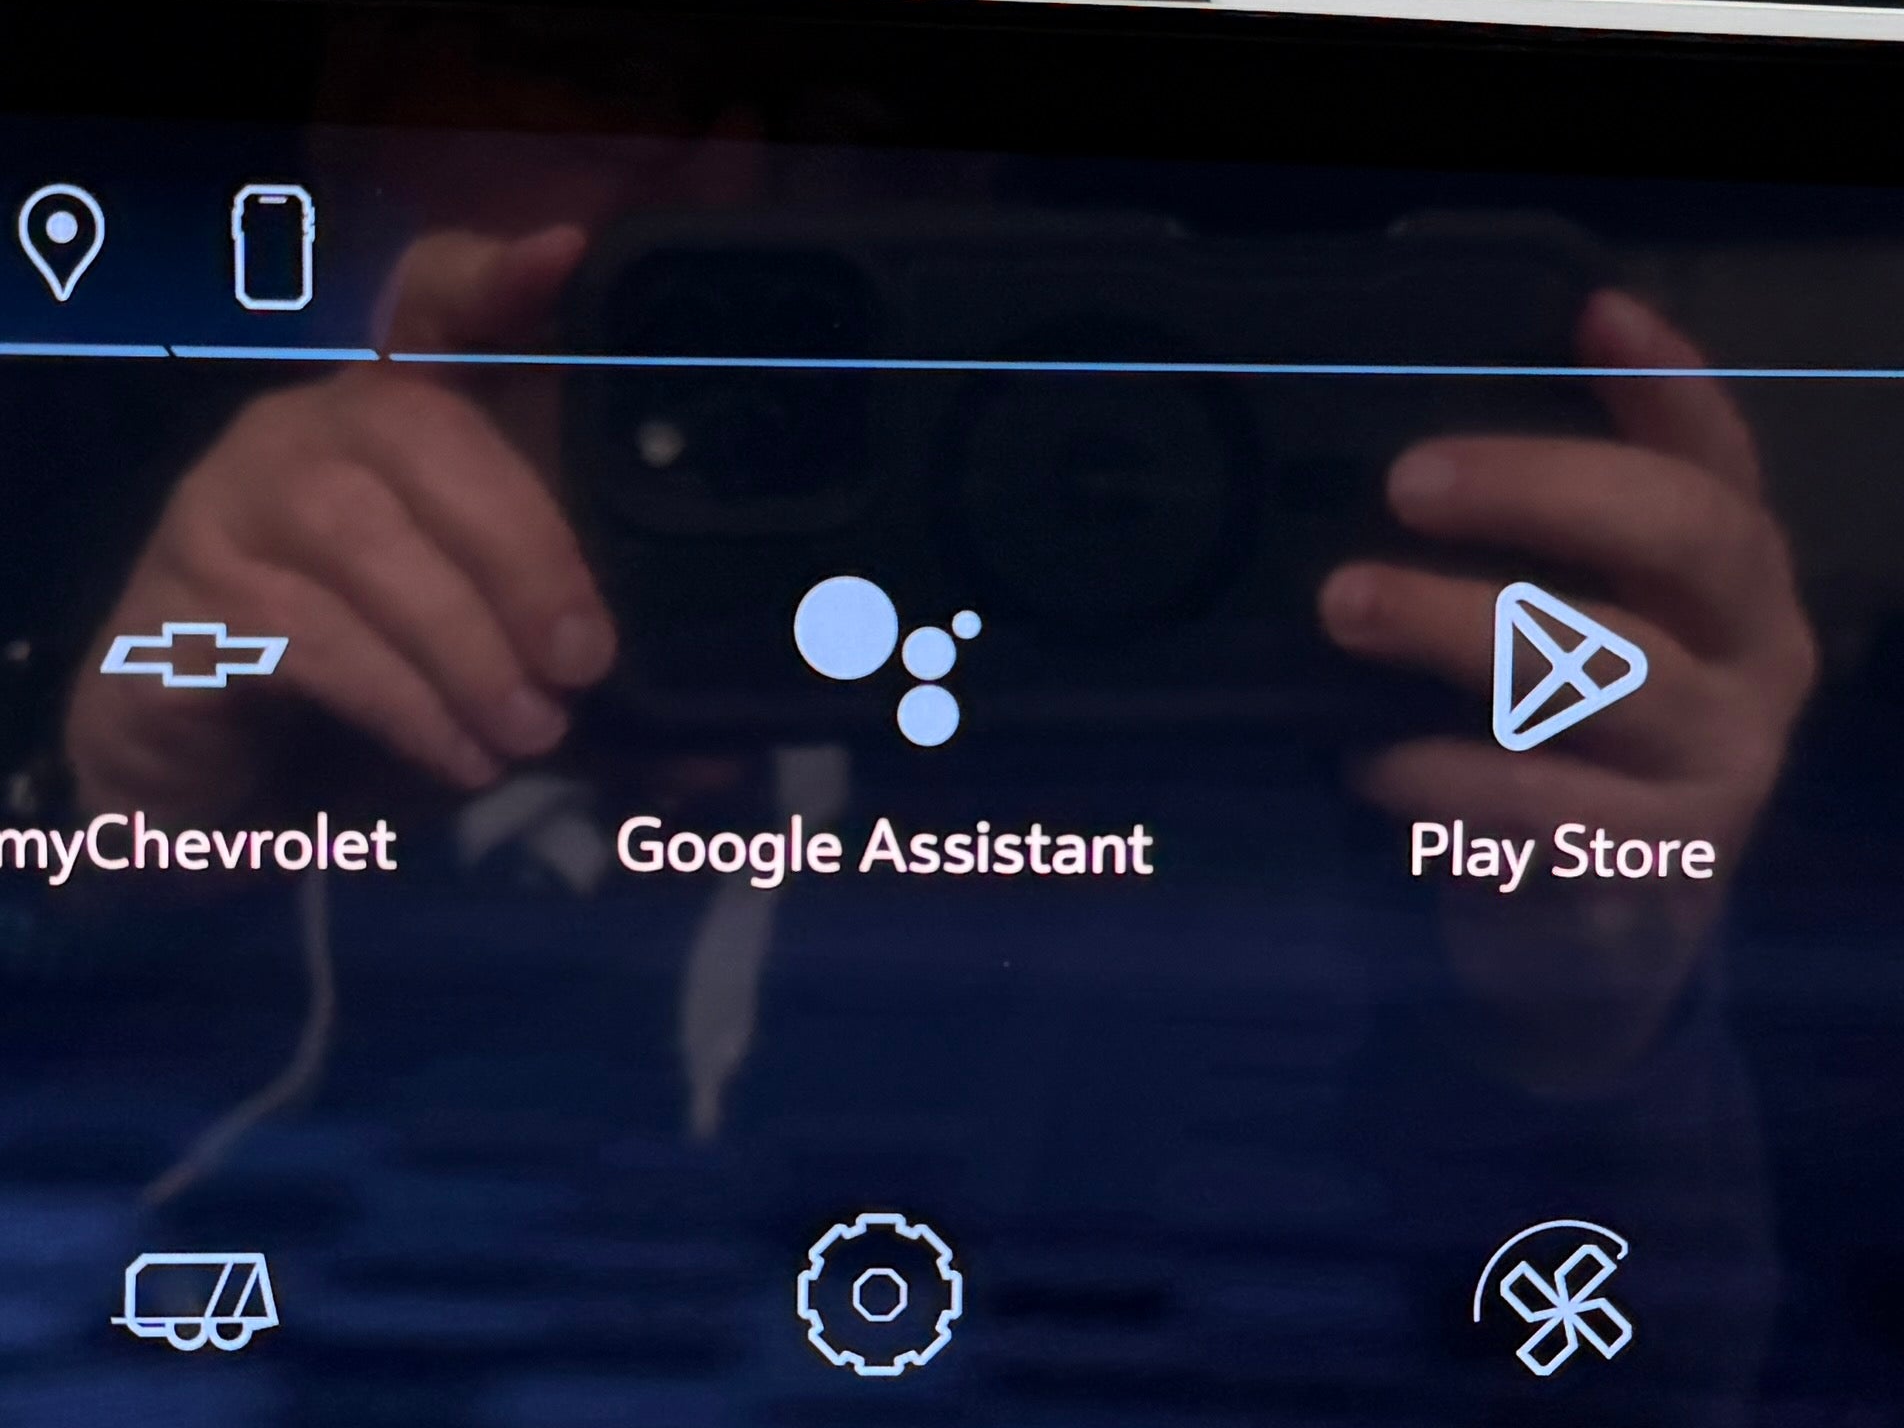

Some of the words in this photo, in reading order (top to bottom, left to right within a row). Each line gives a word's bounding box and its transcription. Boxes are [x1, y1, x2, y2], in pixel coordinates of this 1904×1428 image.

[616, 813, 844, 890] Google
[858, 816, 1155, 876] Assistant
[1410, 818, 1537, 895] Play
[1560, 821, 1717, 880] Store
